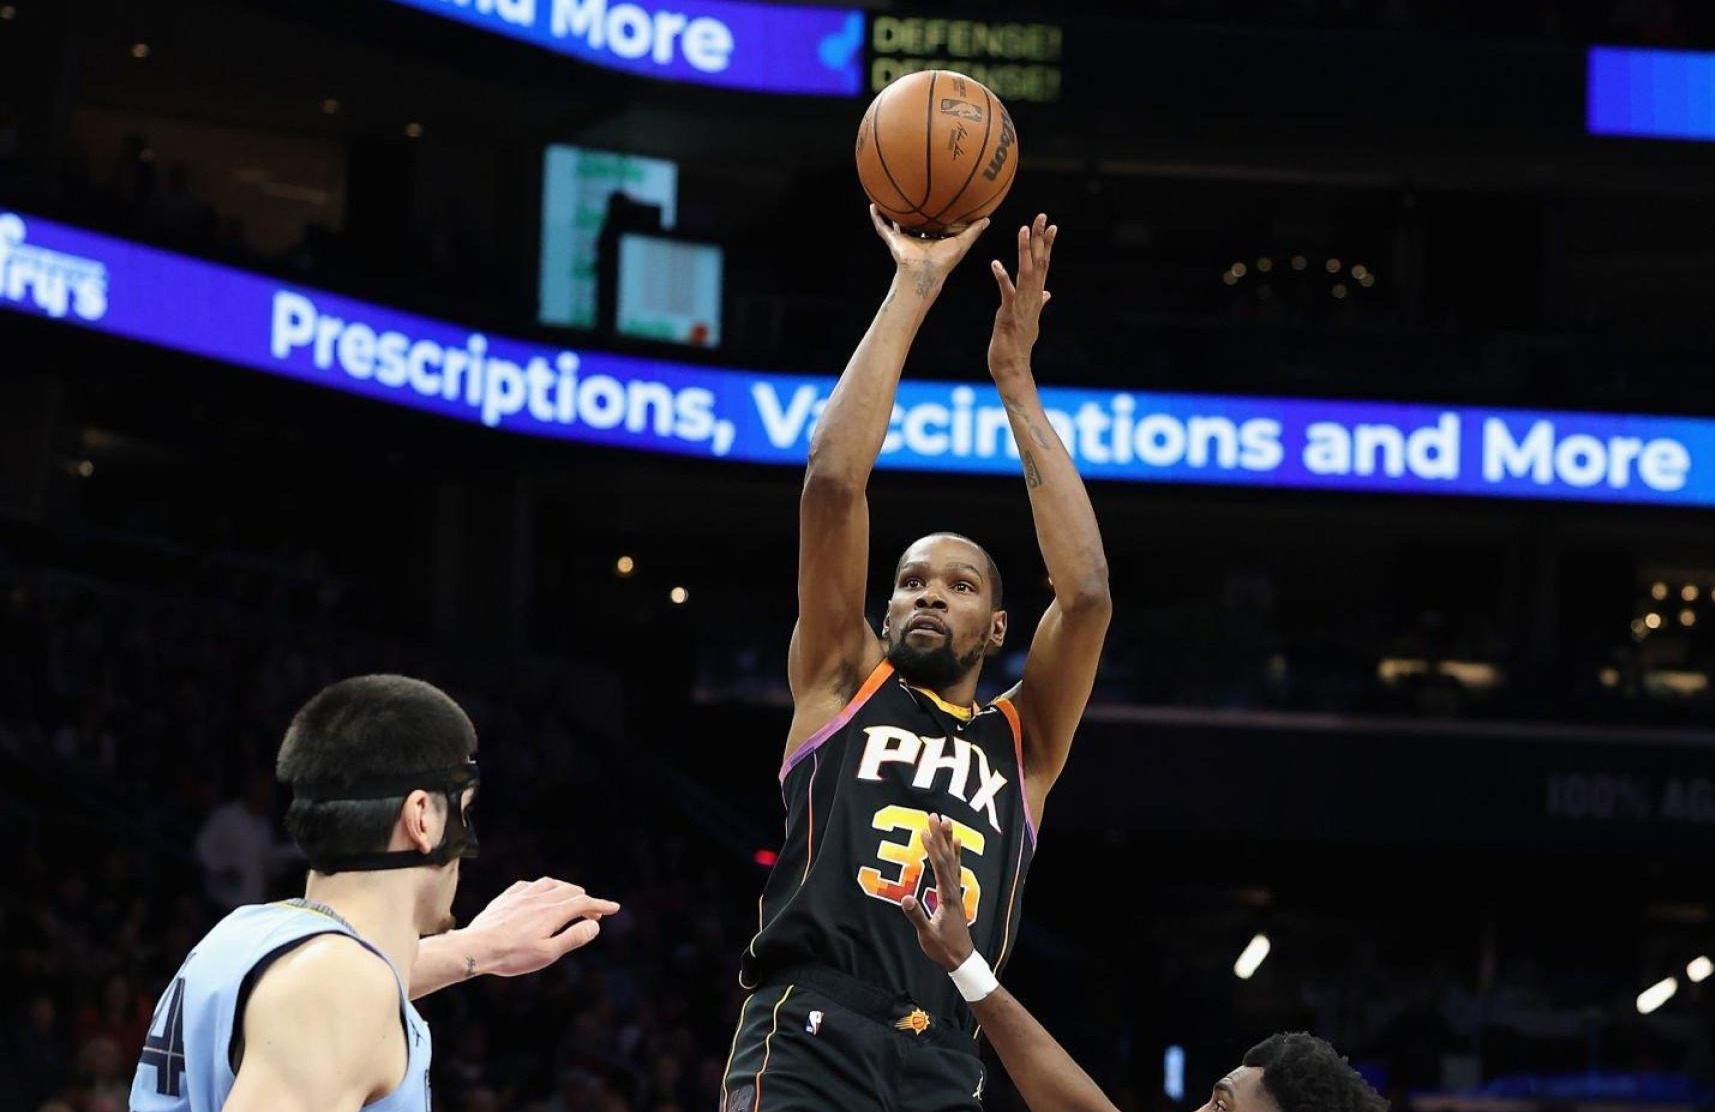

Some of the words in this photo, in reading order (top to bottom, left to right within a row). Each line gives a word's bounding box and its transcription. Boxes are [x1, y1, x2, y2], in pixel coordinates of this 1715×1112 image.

[550, 0, 735, 73] More
[873, 16, 1063, 60] DEFENSE!
[270, 290, 735, 456] Prescriptions,
[750, 382, 1285, 471] Vcintions
[1302, 411, 1460, 481] and
[1482, 416, 1691, 491] More
[857, 725, 1008, 834] PHX
[857, 804, 985, 927] 35
